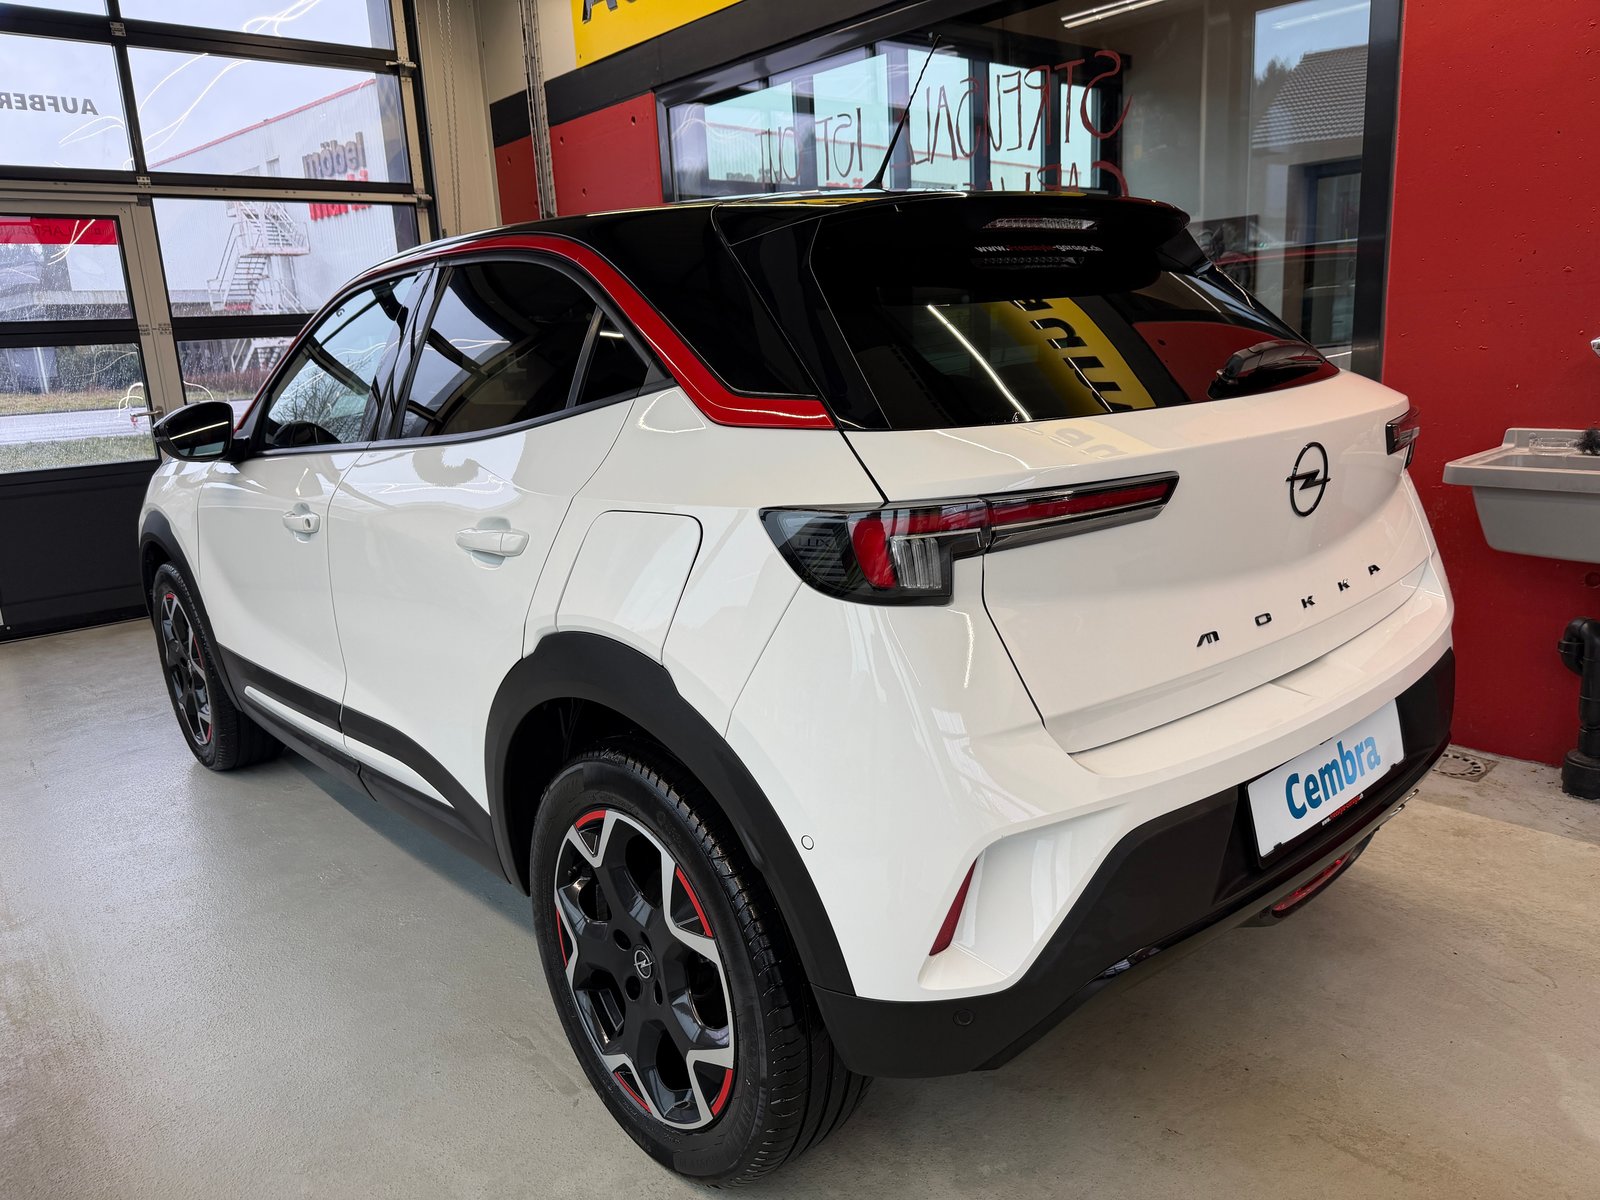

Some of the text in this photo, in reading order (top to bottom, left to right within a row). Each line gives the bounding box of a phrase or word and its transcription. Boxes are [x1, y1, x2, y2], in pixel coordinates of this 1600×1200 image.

[302, 131, 367, 179] möbel
[1196, 564, 1381, 648] MOKKA
[1285, 736, 1381, 820] Cembra
